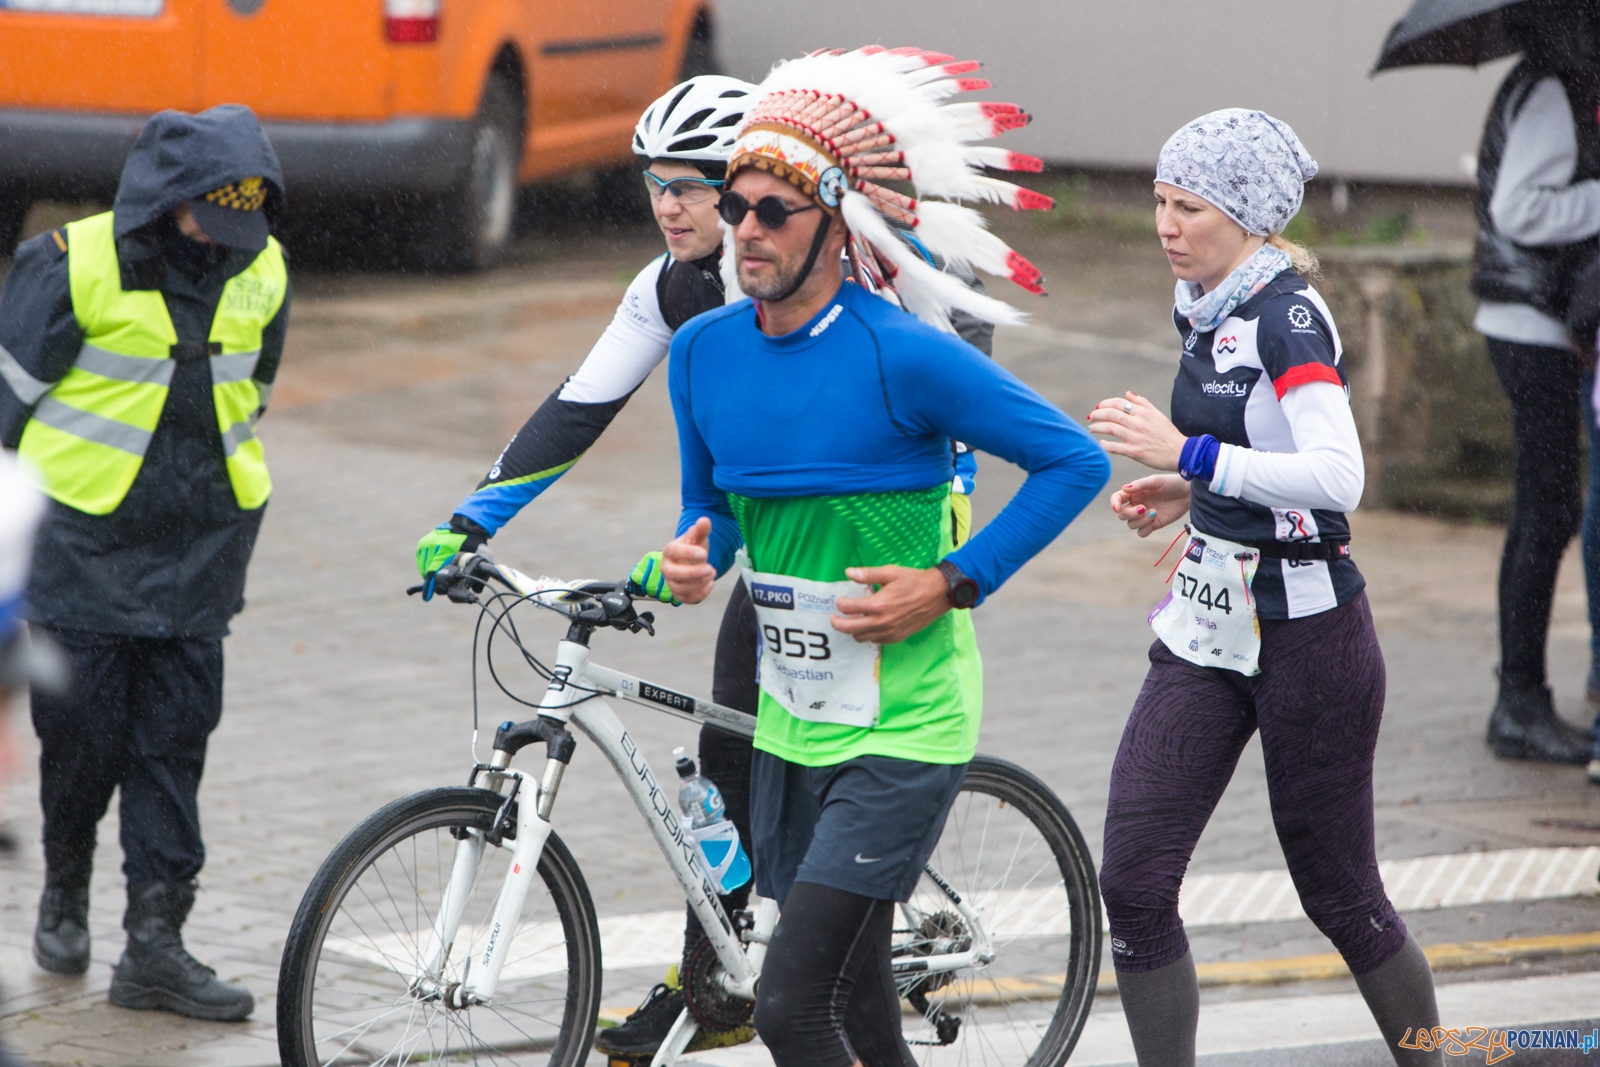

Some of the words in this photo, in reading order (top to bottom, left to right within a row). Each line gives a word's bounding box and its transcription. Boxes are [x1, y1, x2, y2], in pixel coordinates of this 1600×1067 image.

[1201, 380, 1247, 397] velocity
[763, 624, 831, 661] 953
[644, 686, 688, 709] EXPERT
[620, 731, 704, 878] EUROBIKE
